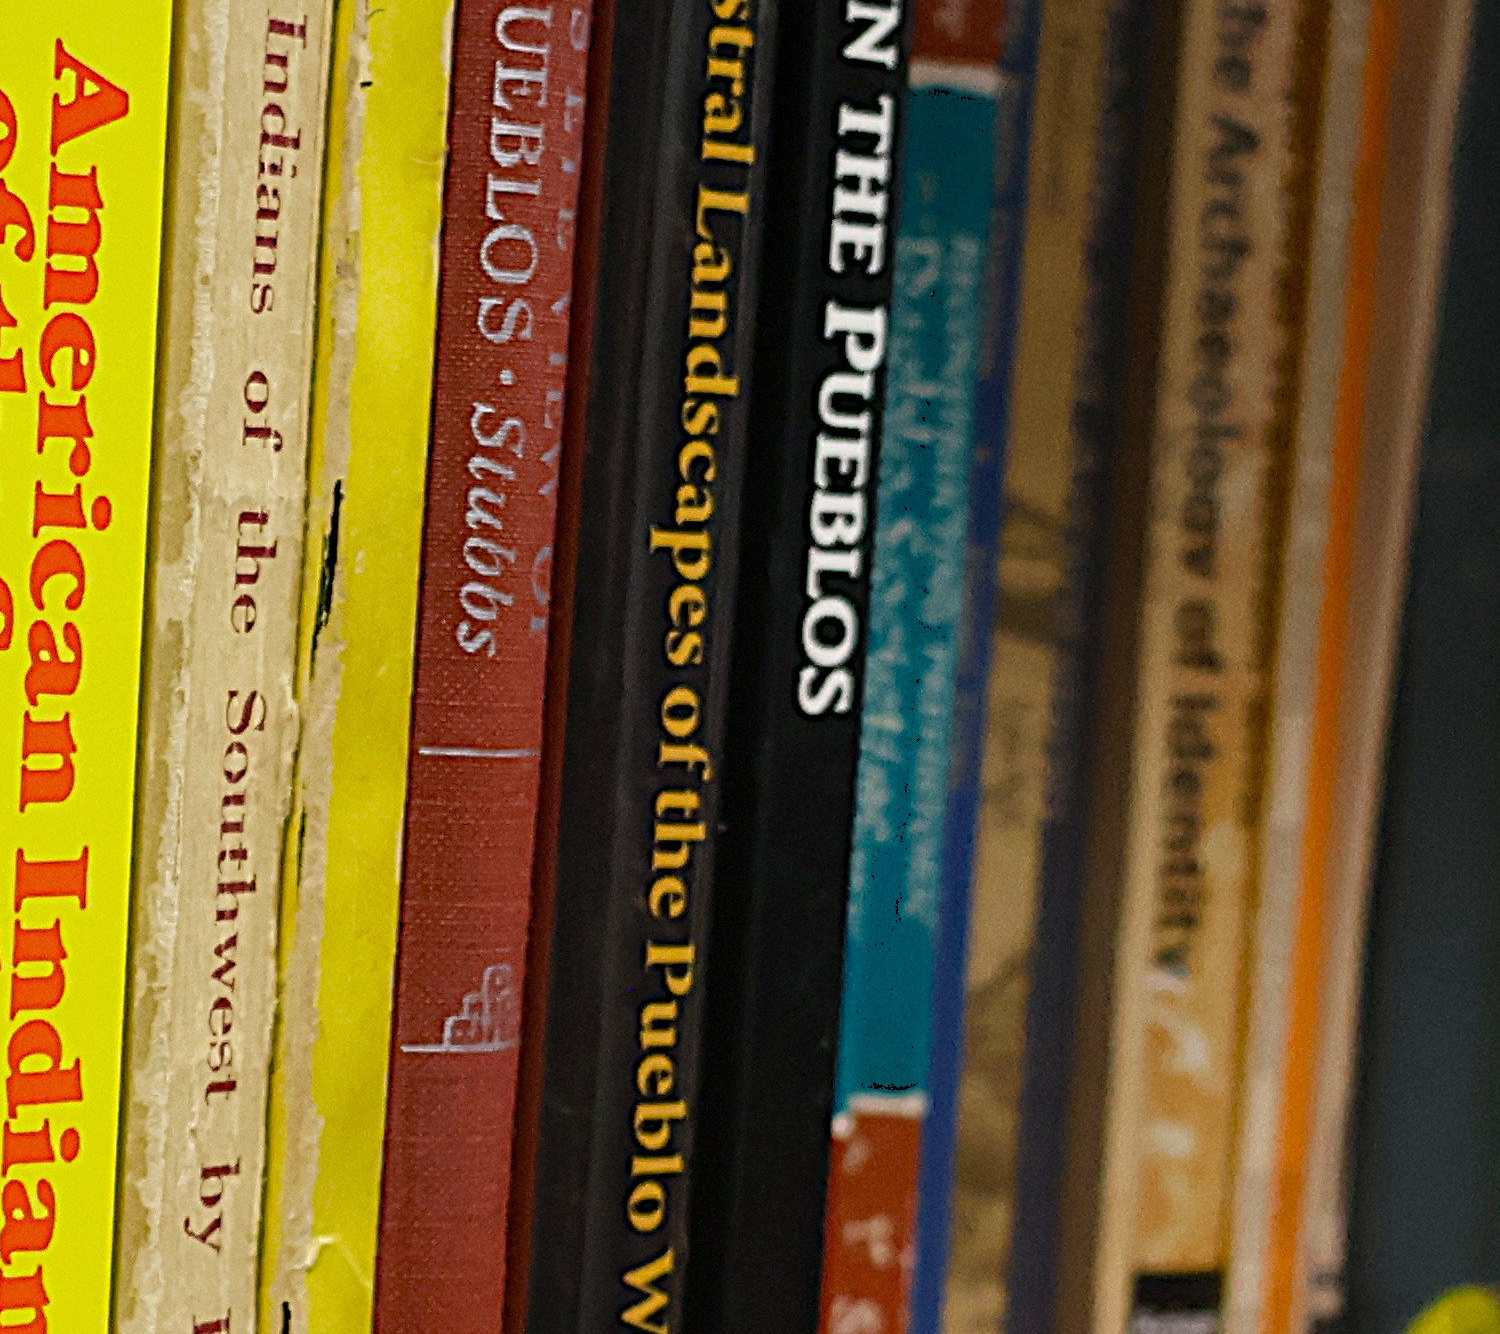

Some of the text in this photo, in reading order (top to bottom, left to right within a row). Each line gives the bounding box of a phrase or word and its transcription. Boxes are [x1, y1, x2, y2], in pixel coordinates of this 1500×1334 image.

[249, 8, 309, 316] Indians
[830, 93, 896, 278] THE
[18, 38, 130, 813] American
[242, 370, 283, 451] of
[456, 401, 525, 661] Stubbs
[650, 179, 752, 667] Landscapes
[798, 300, 889, 718] PUEBLOS
[230, 508, 278, 636] the
[646, 790, 709, 920] the
[656, 682, 714, 784] of
[203, 687, 267, 1106] Southwest
[183, 1158, 241, 1253] by
[623, 944, 698, 1237] Pueblo
